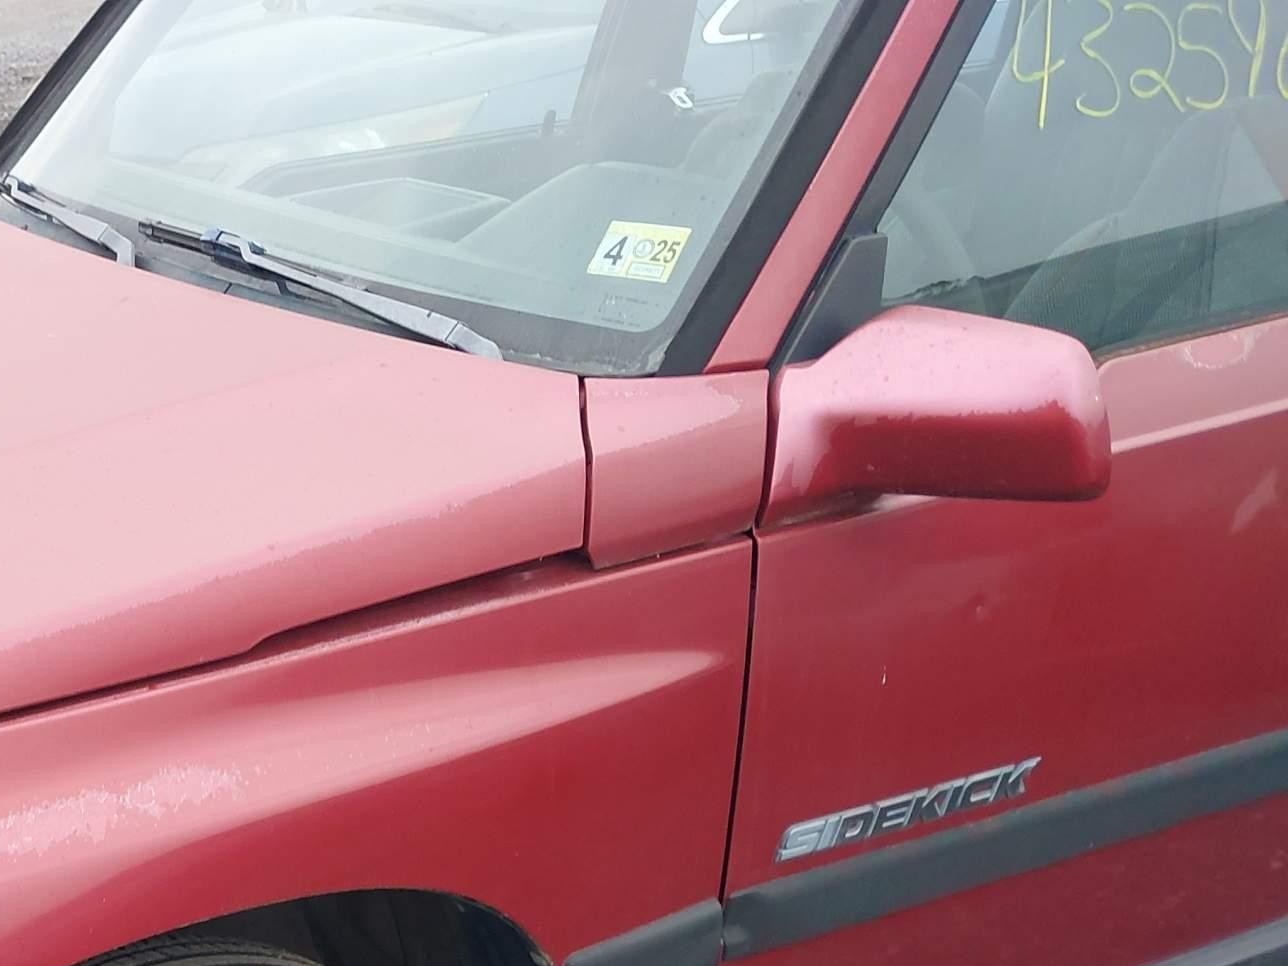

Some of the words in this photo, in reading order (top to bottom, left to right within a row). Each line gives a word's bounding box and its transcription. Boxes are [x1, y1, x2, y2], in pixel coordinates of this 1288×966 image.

[603, 235, 629, 266] 4
[649, 239, 681, 264] 25
[774, 756, 1042, 863] SIDEKICK
